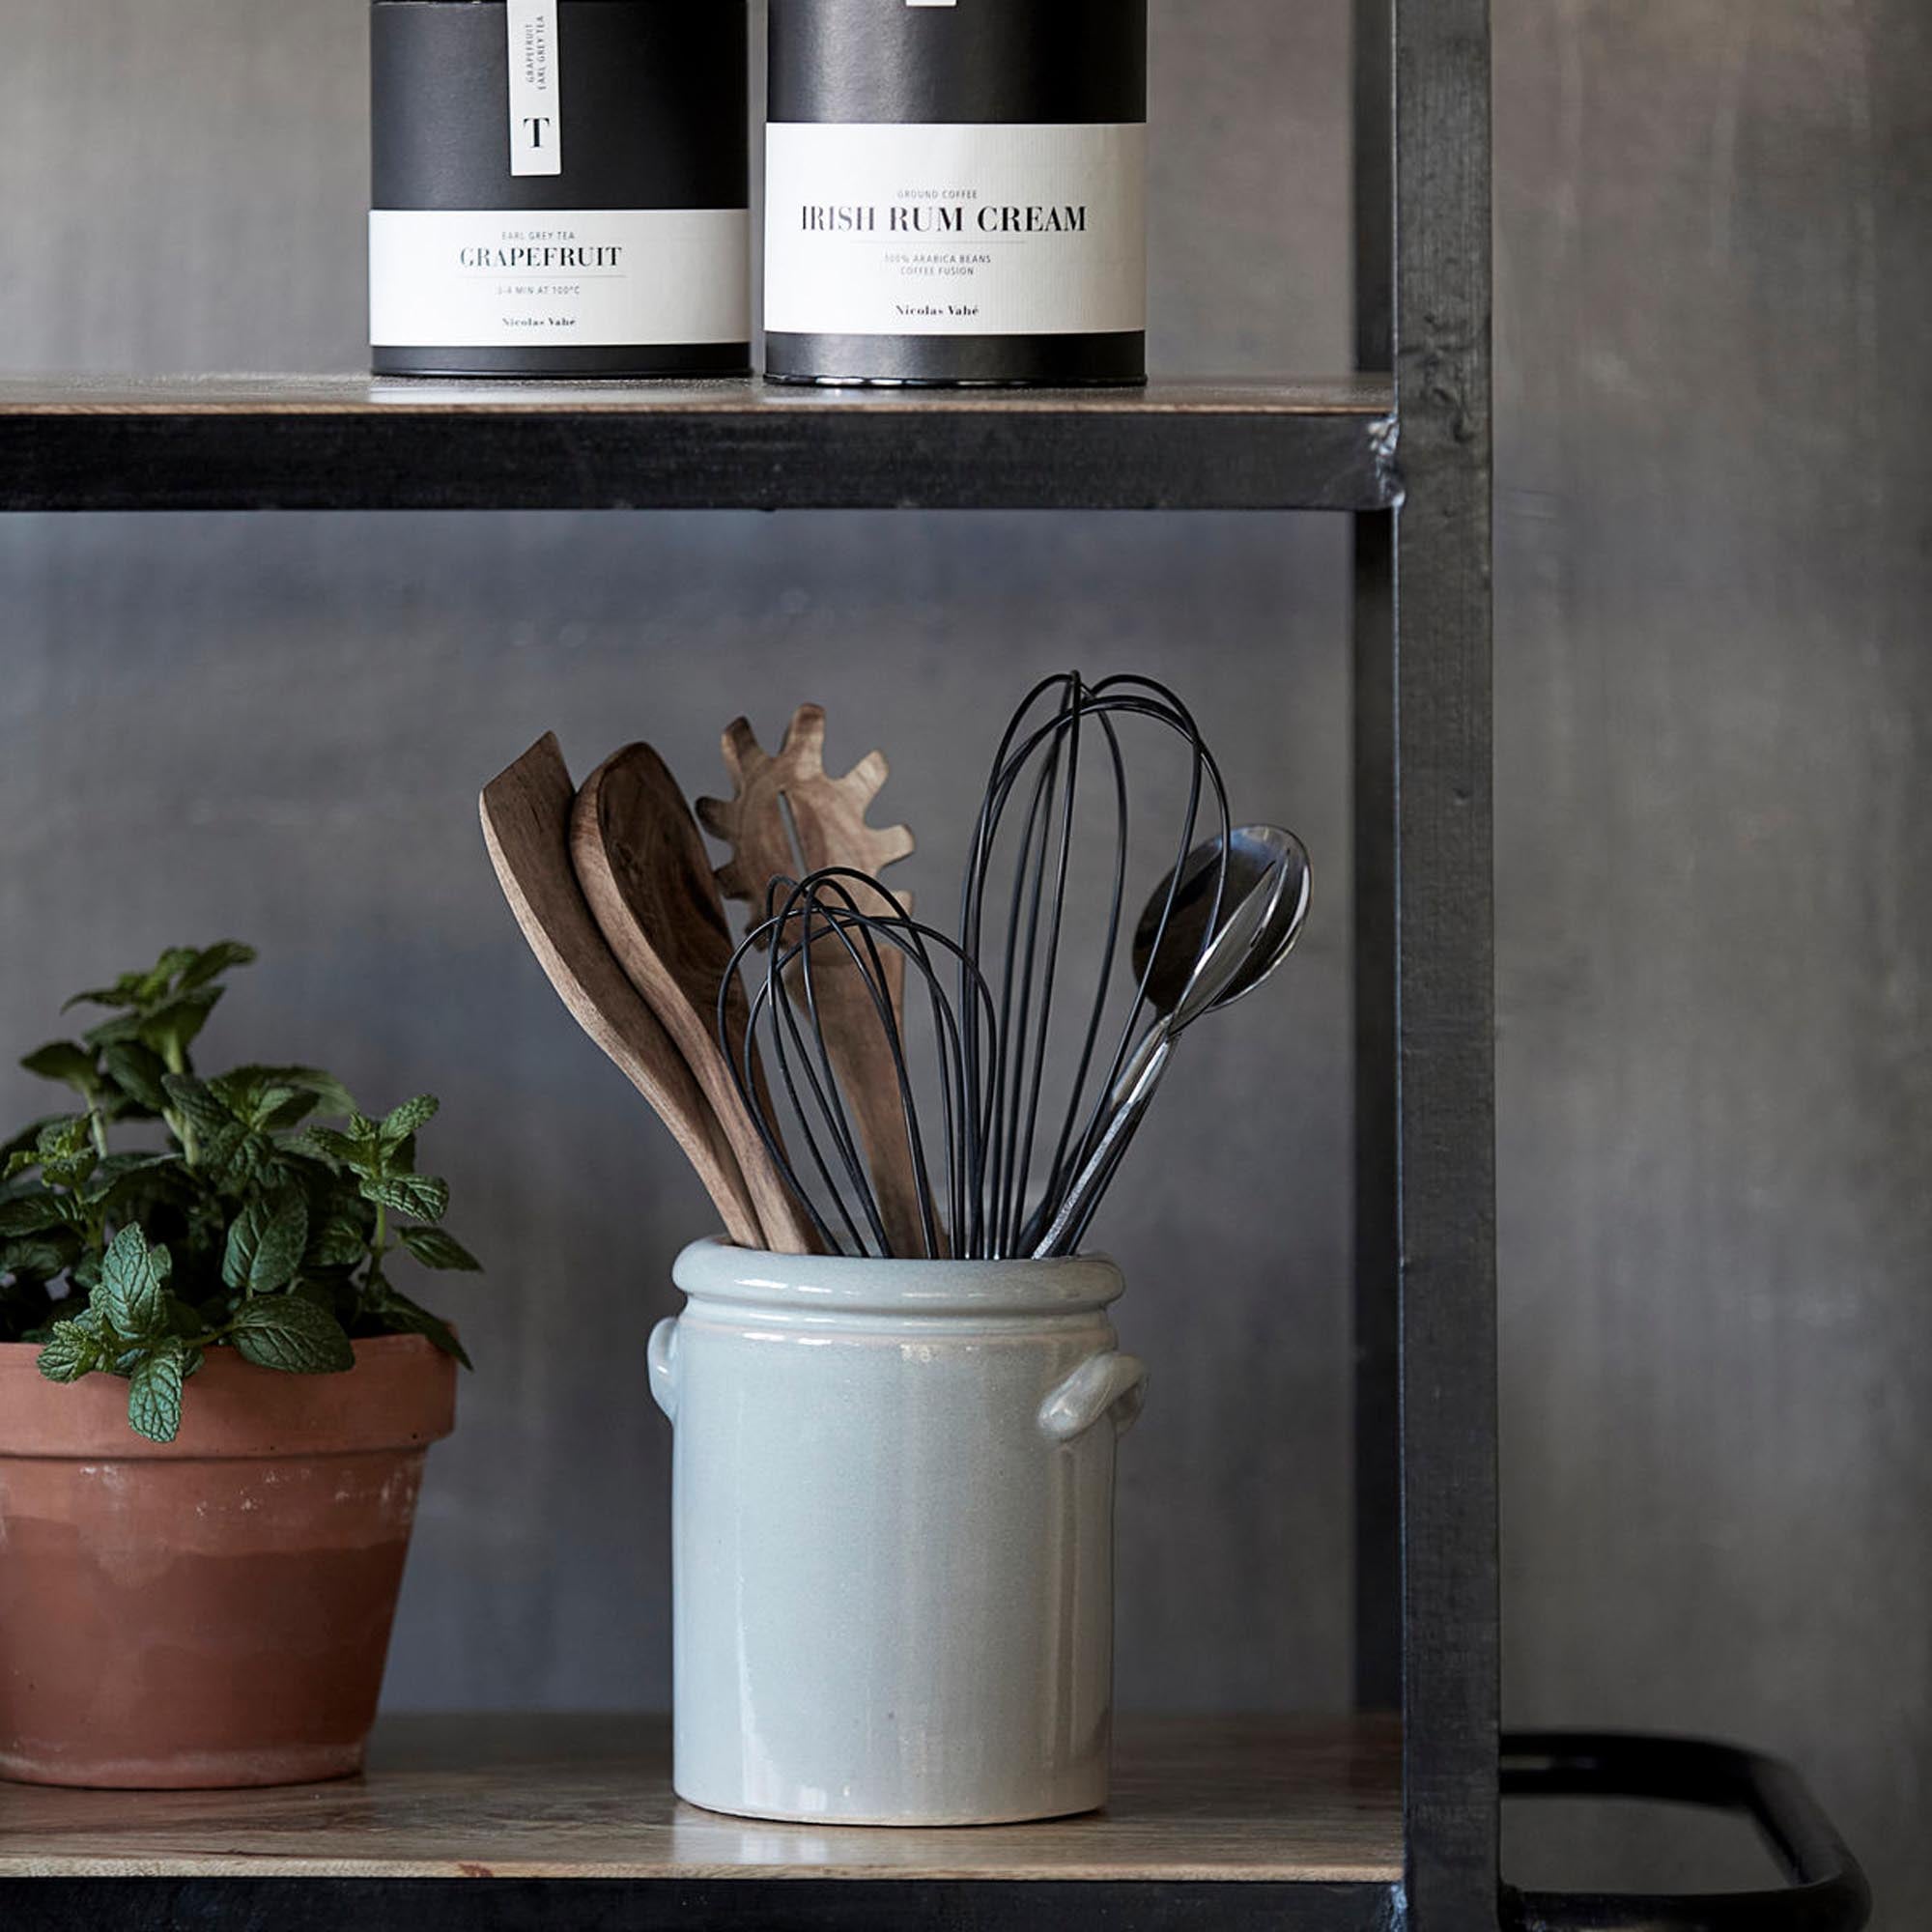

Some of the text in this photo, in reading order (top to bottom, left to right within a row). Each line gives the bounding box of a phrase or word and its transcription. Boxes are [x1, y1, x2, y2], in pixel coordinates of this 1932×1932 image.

[525, 24, 534, 83] GRAPEFRUIT
[536, 15, 547, 90] EARL GREY TEA
[523, 117, 551, 148] T
[897, 189, 978, 199] GROUND COFFEE
[802, 205, 1087, 232] IRISH RUM CREAM
[501, 231, 576, 241] EARL GREY TEA
[460, 247, 622, 267] GRAPEFRUIT
[913, 254, 956, 263] ARABICA
[959, 254, 991, 263] BEANS
[900, 267, 974, 275] COFFEE FUSION
[515, 285, 535, 295] MIN
[537, 285, 550, 295] AT
[895, 304, 944, 315] Nicolas
[501, 317, 545, 327] Nicolas
